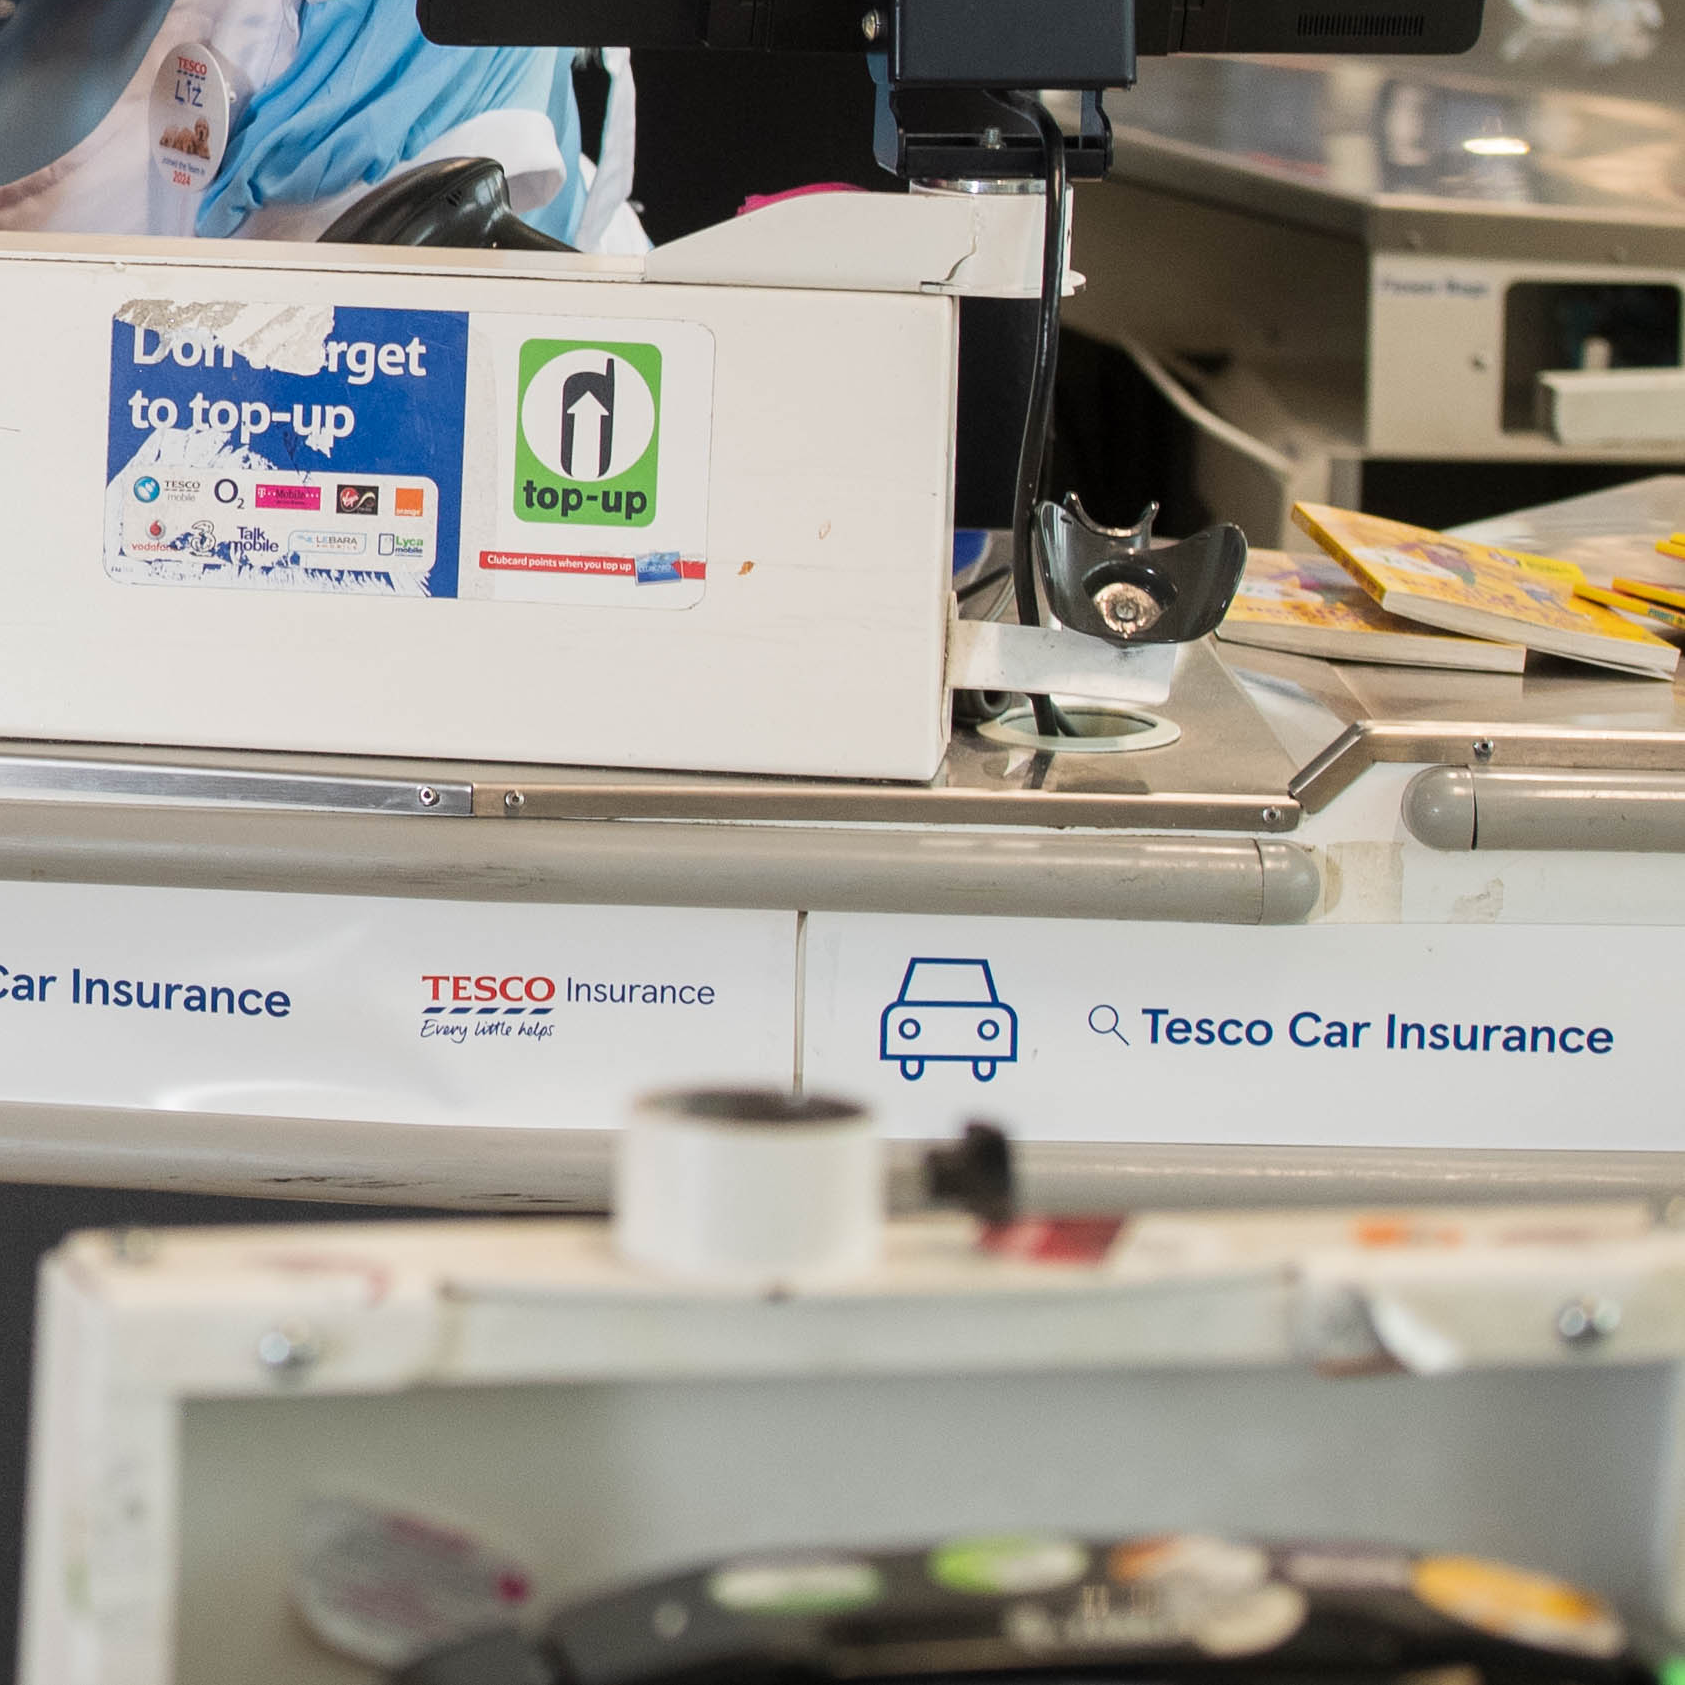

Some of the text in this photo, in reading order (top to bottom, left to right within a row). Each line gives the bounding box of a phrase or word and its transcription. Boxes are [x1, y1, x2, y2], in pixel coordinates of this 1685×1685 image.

[177, 56, 208, 75] TESCO
[128, 389, 356, 446] to top-up
[163, 479, 202, 491] TESCO
[167, 492, 197, 503] mobile
[522, 479, 648, 521] top-up
[229, 538, 280, 554] mobile
[237, 525, 425, 548] Talk Lyca
[316, 534, 359, 545] LEBARA
[487, 554, 619, 572] Clubcard points when you top
[71, 967, 292, 1018] Insurance
[421, 974, 716, 1006] TESCO Insurance
[420, 1018, 556, 1045] Every little helps
[1141, 1007, 1616, 1055] Tesco Car Insurance
